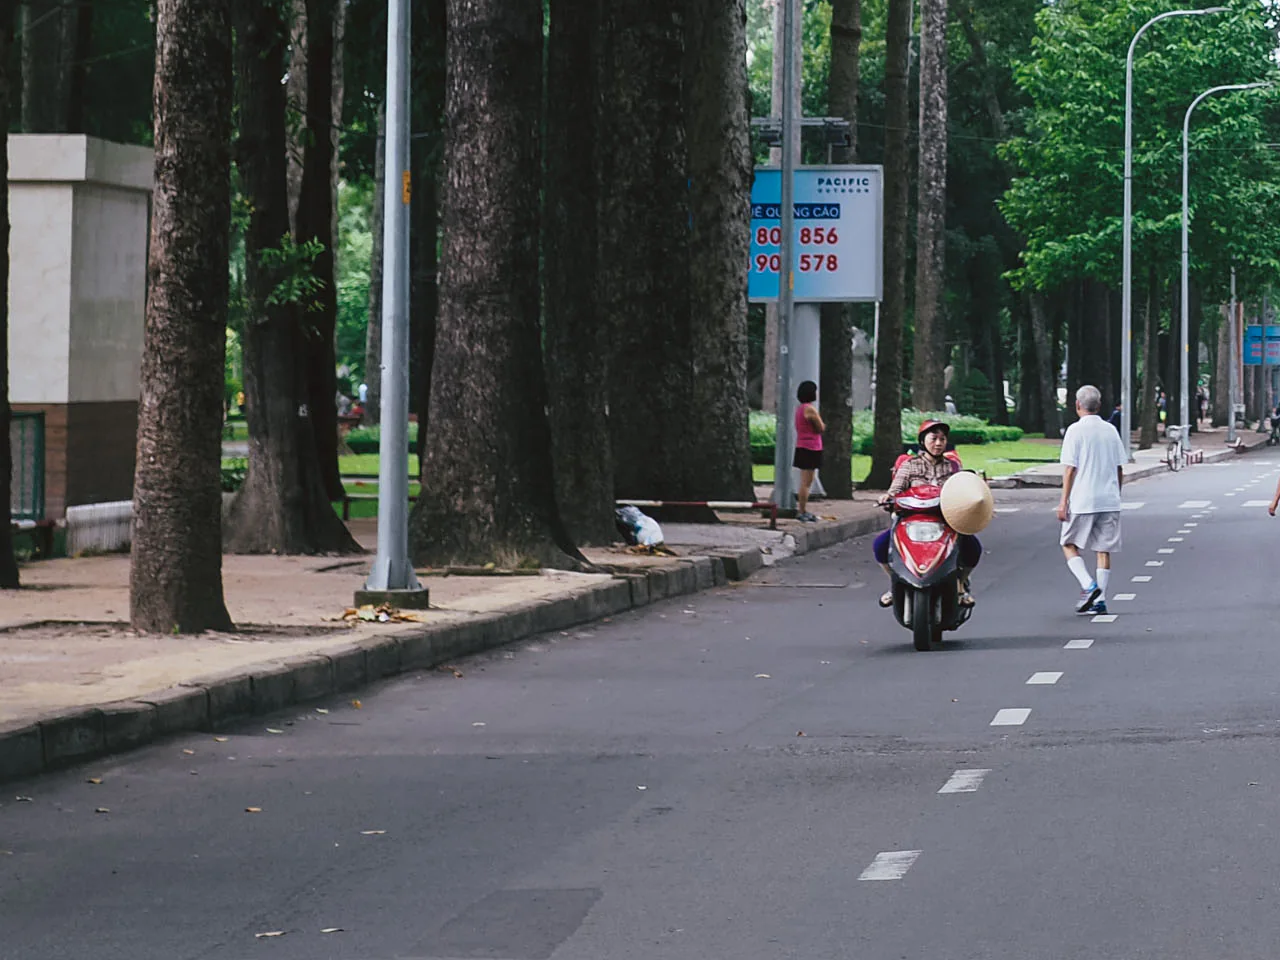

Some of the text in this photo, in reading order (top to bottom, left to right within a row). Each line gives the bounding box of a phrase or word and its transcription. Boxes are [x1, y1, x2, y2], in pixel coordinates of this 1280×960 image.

[817, 177, 869, 186] PACIFIC
[756, 226, 839, 245] 80 856
[756, 253, 838, 272] 90 578
